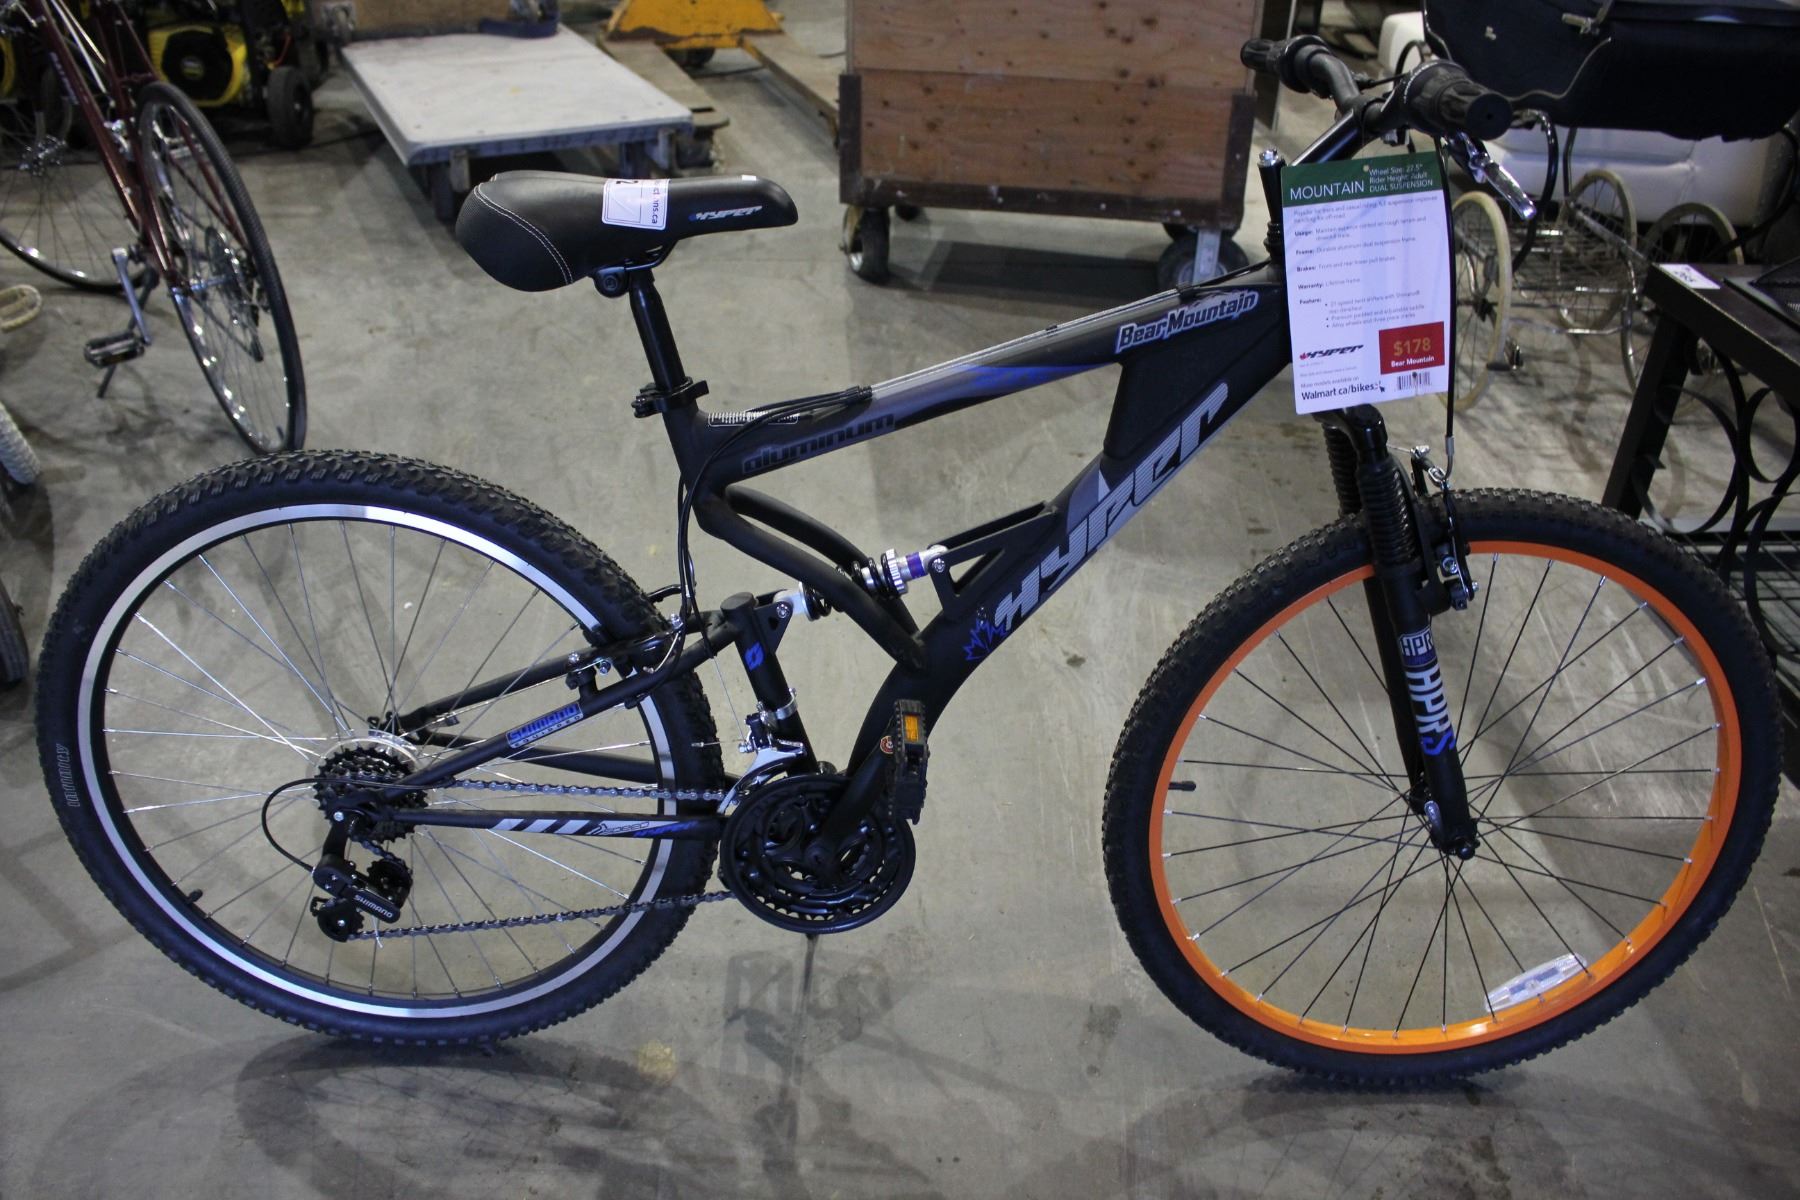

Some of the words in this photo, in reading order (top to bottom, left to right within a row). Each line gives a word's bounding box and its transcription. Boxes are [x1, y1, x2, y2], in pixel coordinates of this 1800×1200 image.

[1290, 180, 1364, 200] MOUNTAIN
[1370, 184, 1388, 192] DUAL
[1390, 179, 1433, 190] SUSPENSION
[1393, 337, 1431, 356] $178
[1407, 355, 1434, 365] Mountain
[995, 383, 1228, 631] HYPER
[1405, 663, 1457, 756] HPRS
[354, 894, 393, 918] SHIMANO
